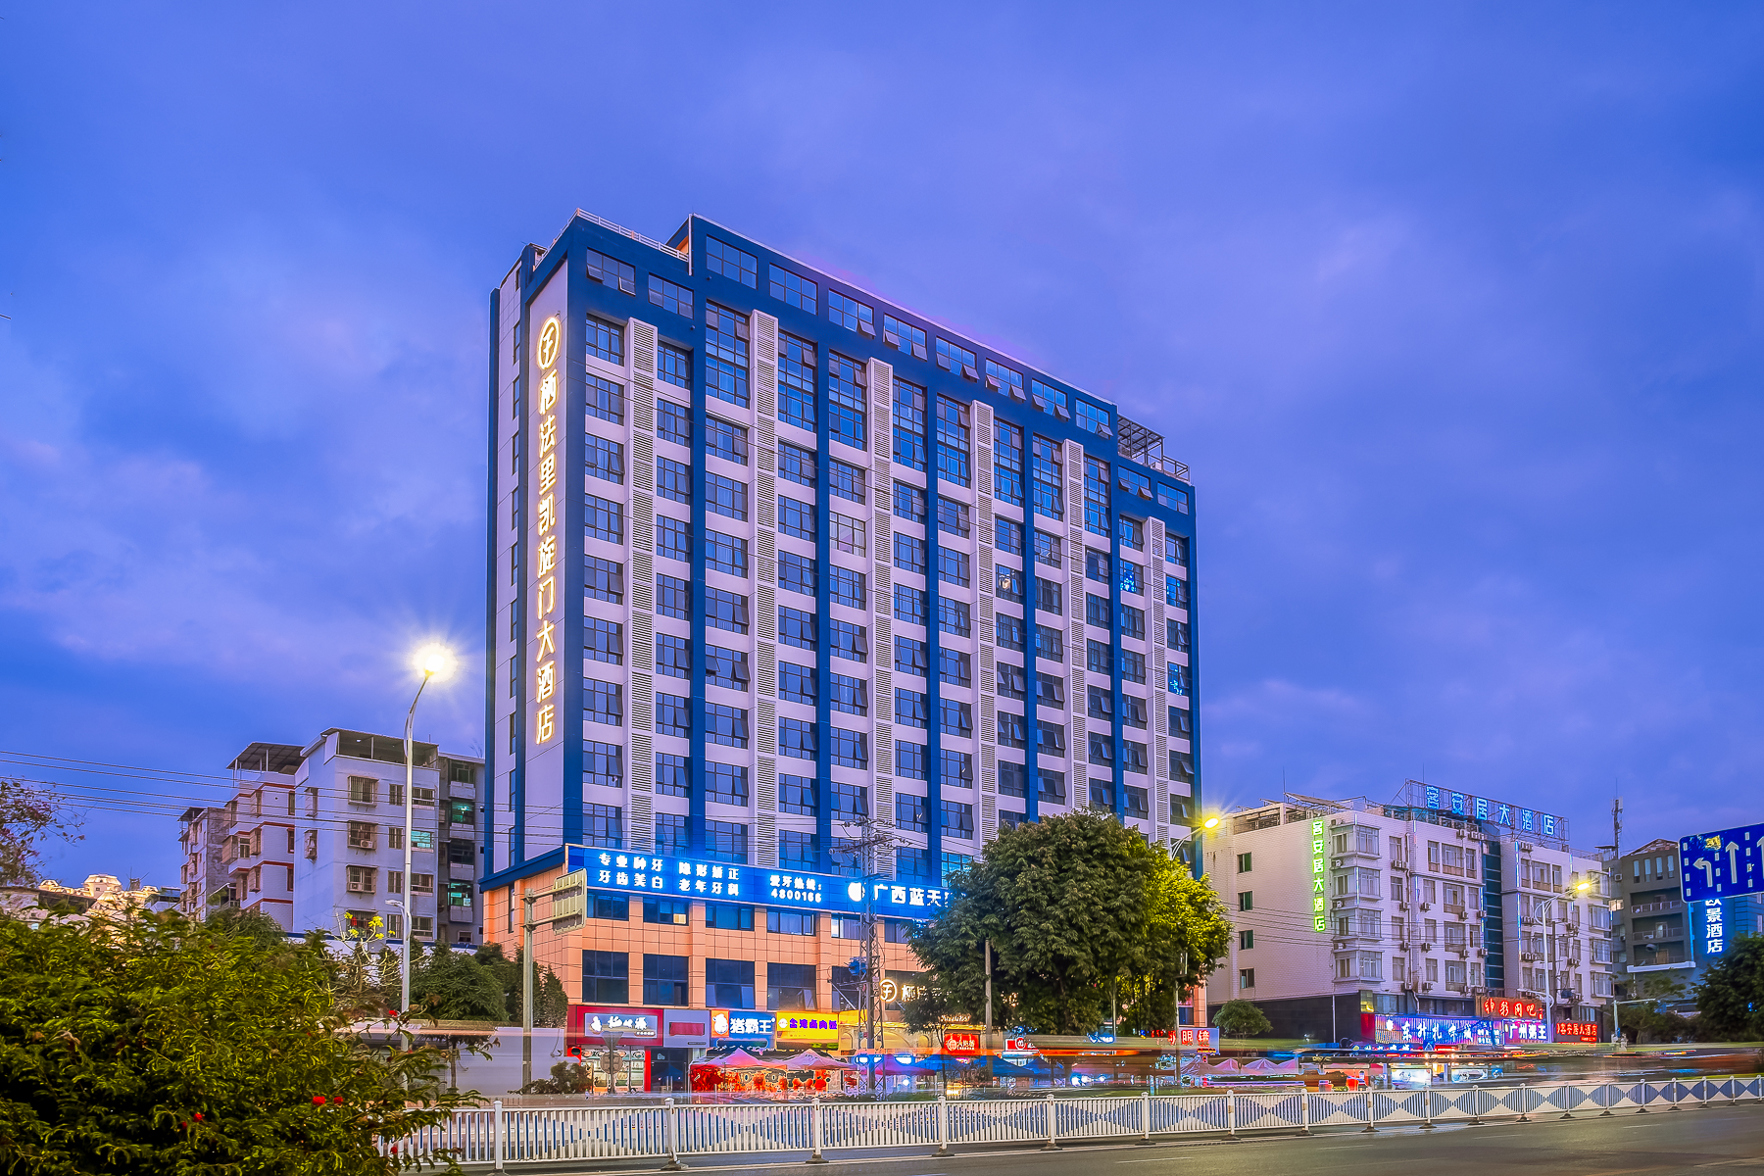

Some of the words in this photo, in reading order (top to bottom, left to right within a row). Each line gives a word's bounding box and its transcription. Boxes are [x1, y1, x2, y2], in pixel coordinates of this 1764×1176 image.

[1426, 785, 1555, 836] 客安居大酒店
[598, 869, 663, 889] 牙齿美白
[678, 878, 740, 896] 老年牙科
[1312, 820, 1325, 931] 客安居大酒店
[730, 1017, 773, 1034] 猪霸王
